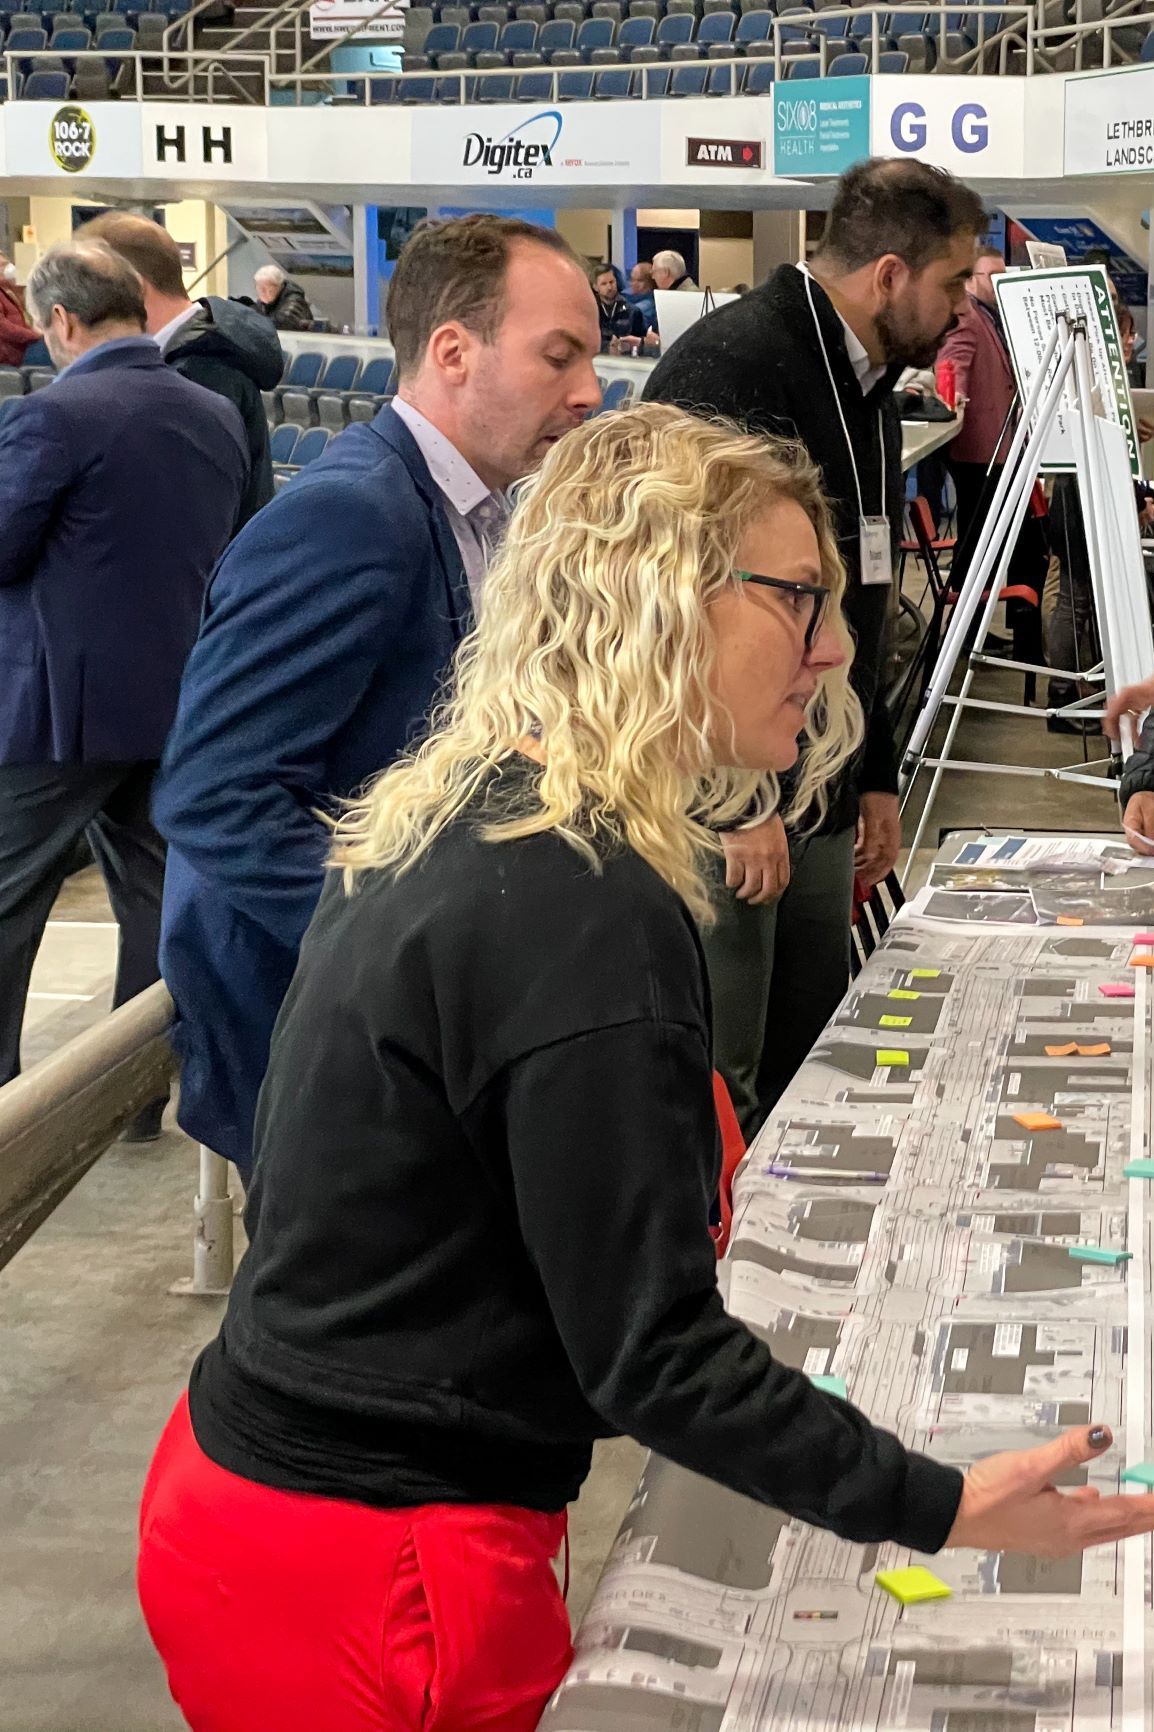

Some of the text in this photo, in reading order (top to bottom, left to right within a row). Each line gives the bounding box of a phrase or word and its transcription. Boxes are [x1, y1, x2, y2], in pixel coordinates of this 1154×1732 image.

[890, 102, 989, 153] G G
[54, 141, 91, 157] ROCK
[156, 125, 232, 163] H H
[463, 133, 553, 174] Digitex
[697, 145, 732, 161] ATM
[780, 139, 815, 155] HEALTH
[513, 167, 532, 178] .ca
[1093, 284, 1136, 459] ATTENTION
[1056, 414, 1066, 435] Park
